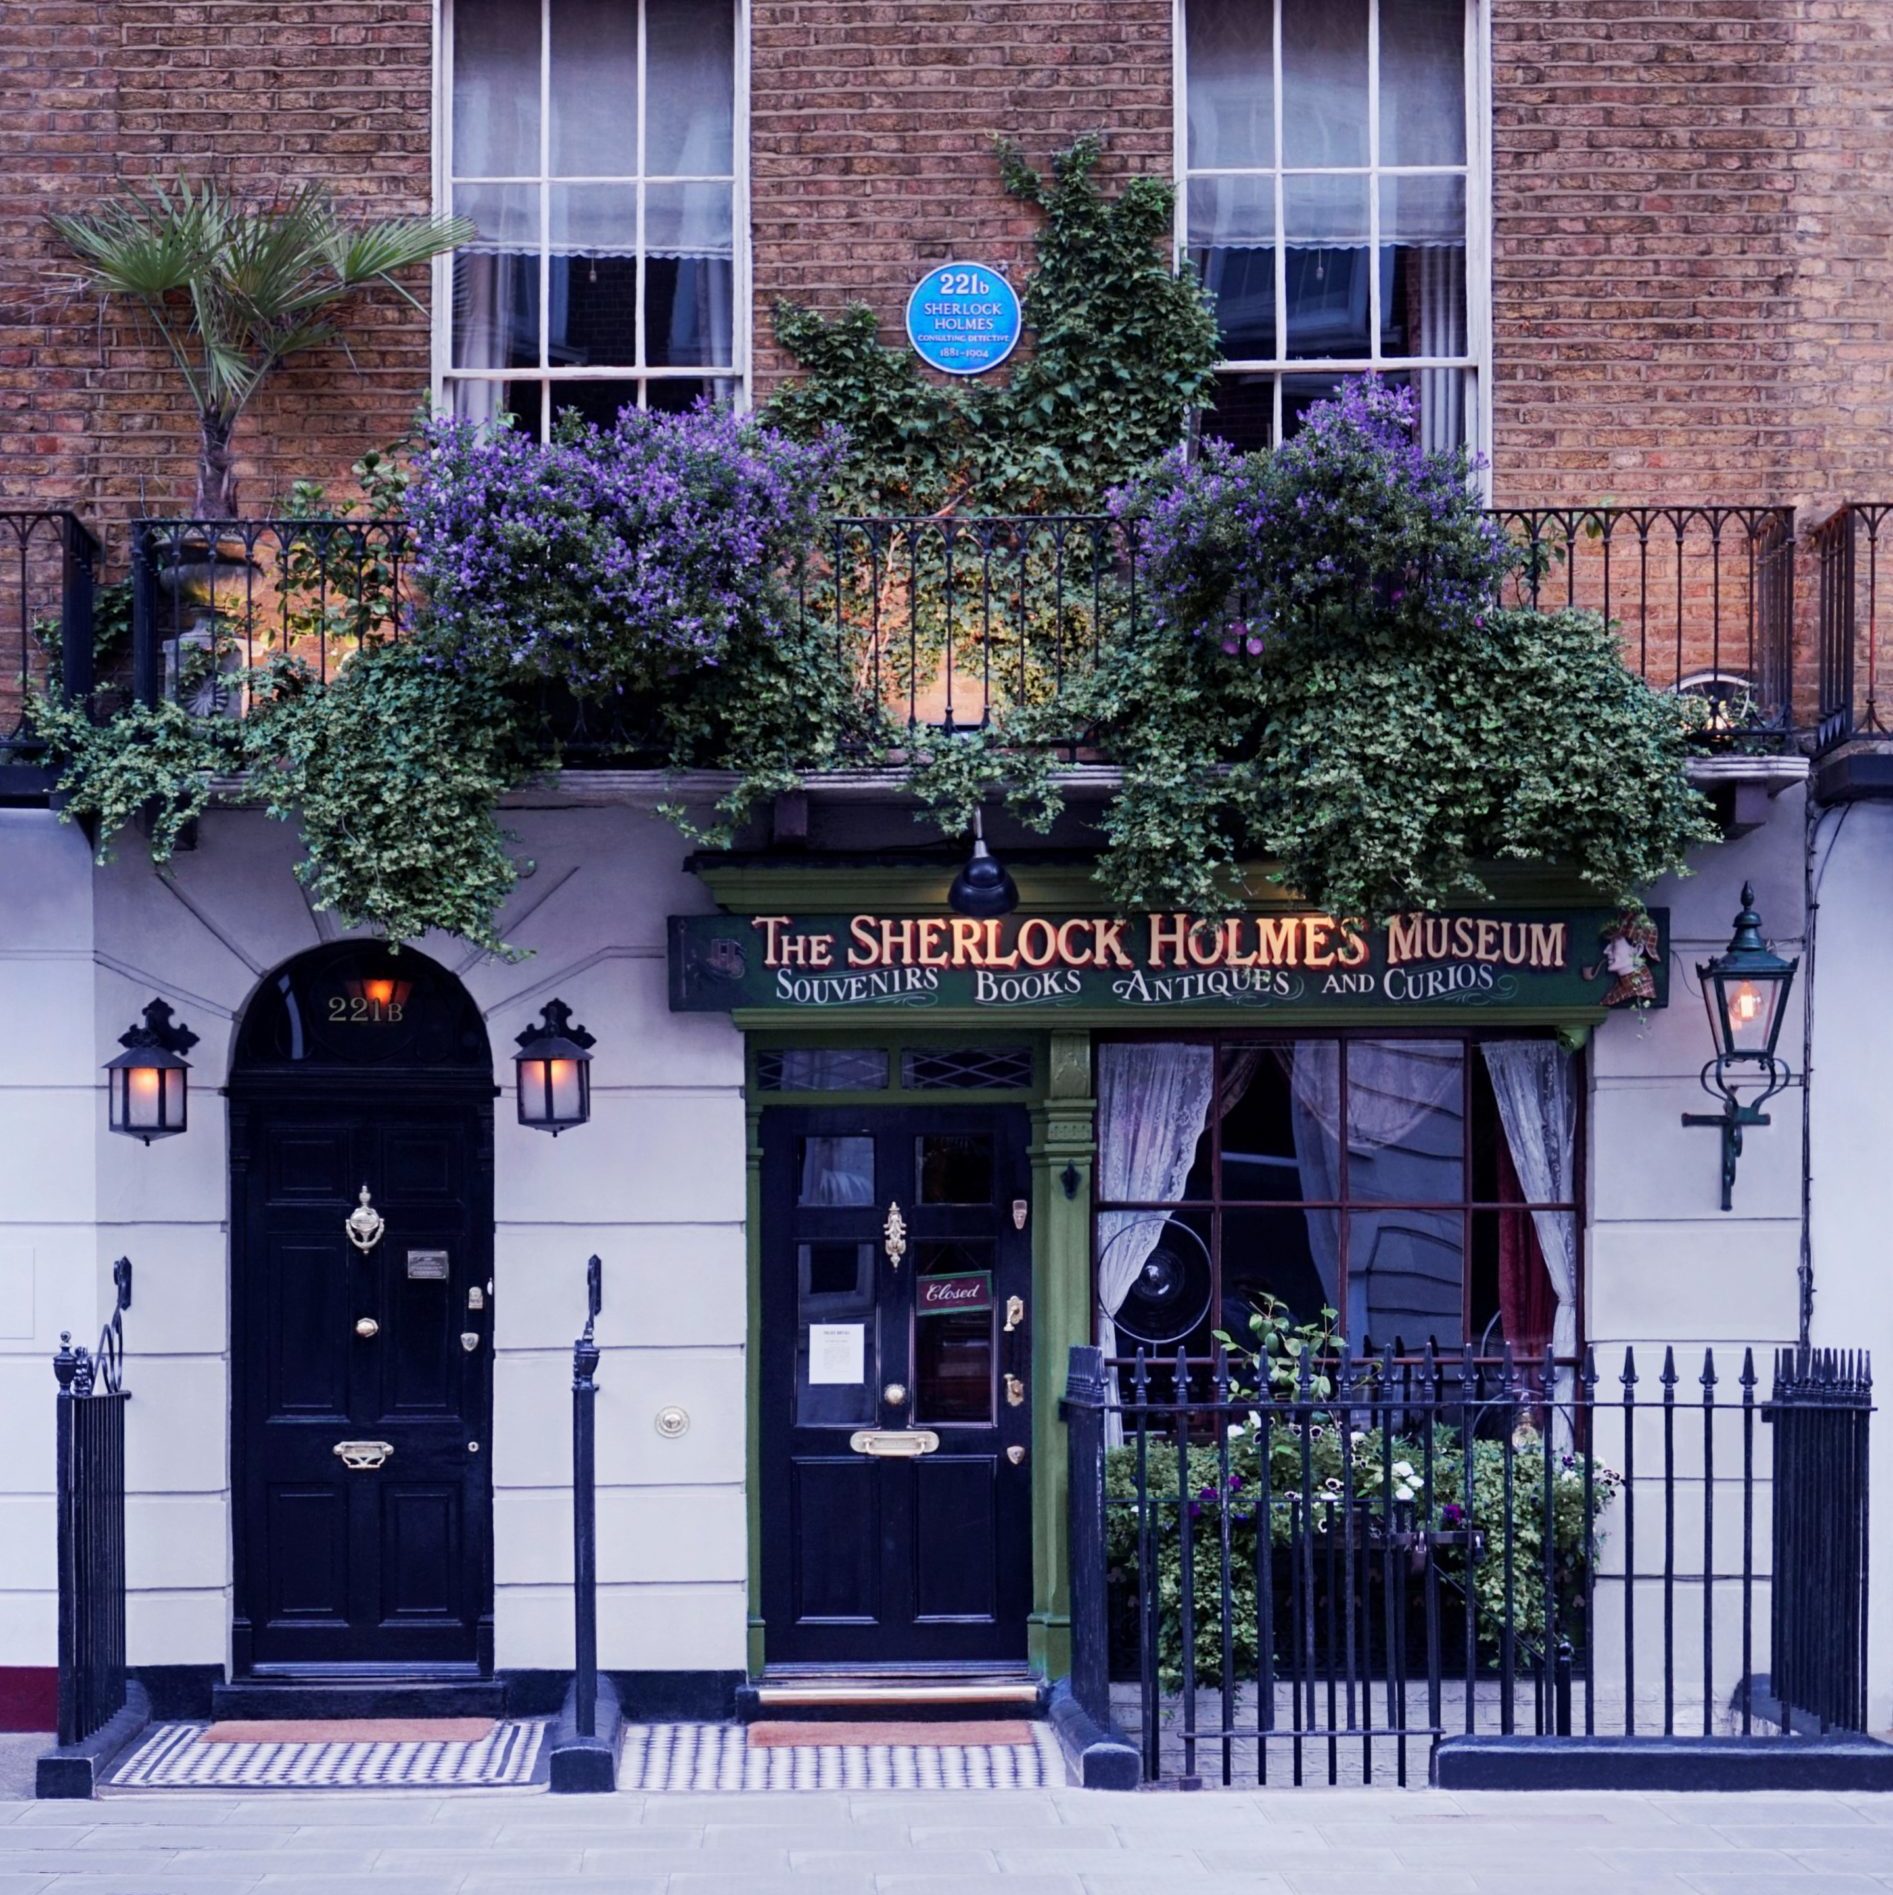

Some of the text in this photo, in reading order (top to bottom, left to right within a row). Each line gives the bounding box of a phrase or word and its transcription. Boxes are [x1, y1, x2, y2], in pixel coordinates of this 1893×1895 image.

[940, 273, 989, 294] 221b
[924, 303, 1002, 315] SHERLOCK
[934, 318, 994, 330] HOLMES
[917, 334, 1009, 342] CONSULTING DETECTIVE
[751, 911, 1567, 971] THE SHERLOCK HOLMES MUSEUM
[776, 963, 1494, 1004] SOUVENIRS BOOKS ANTIQUES AND CURIOS
[328, 997, 403, 1021] 221B
[926, 1284, 980, 1301] Closed
